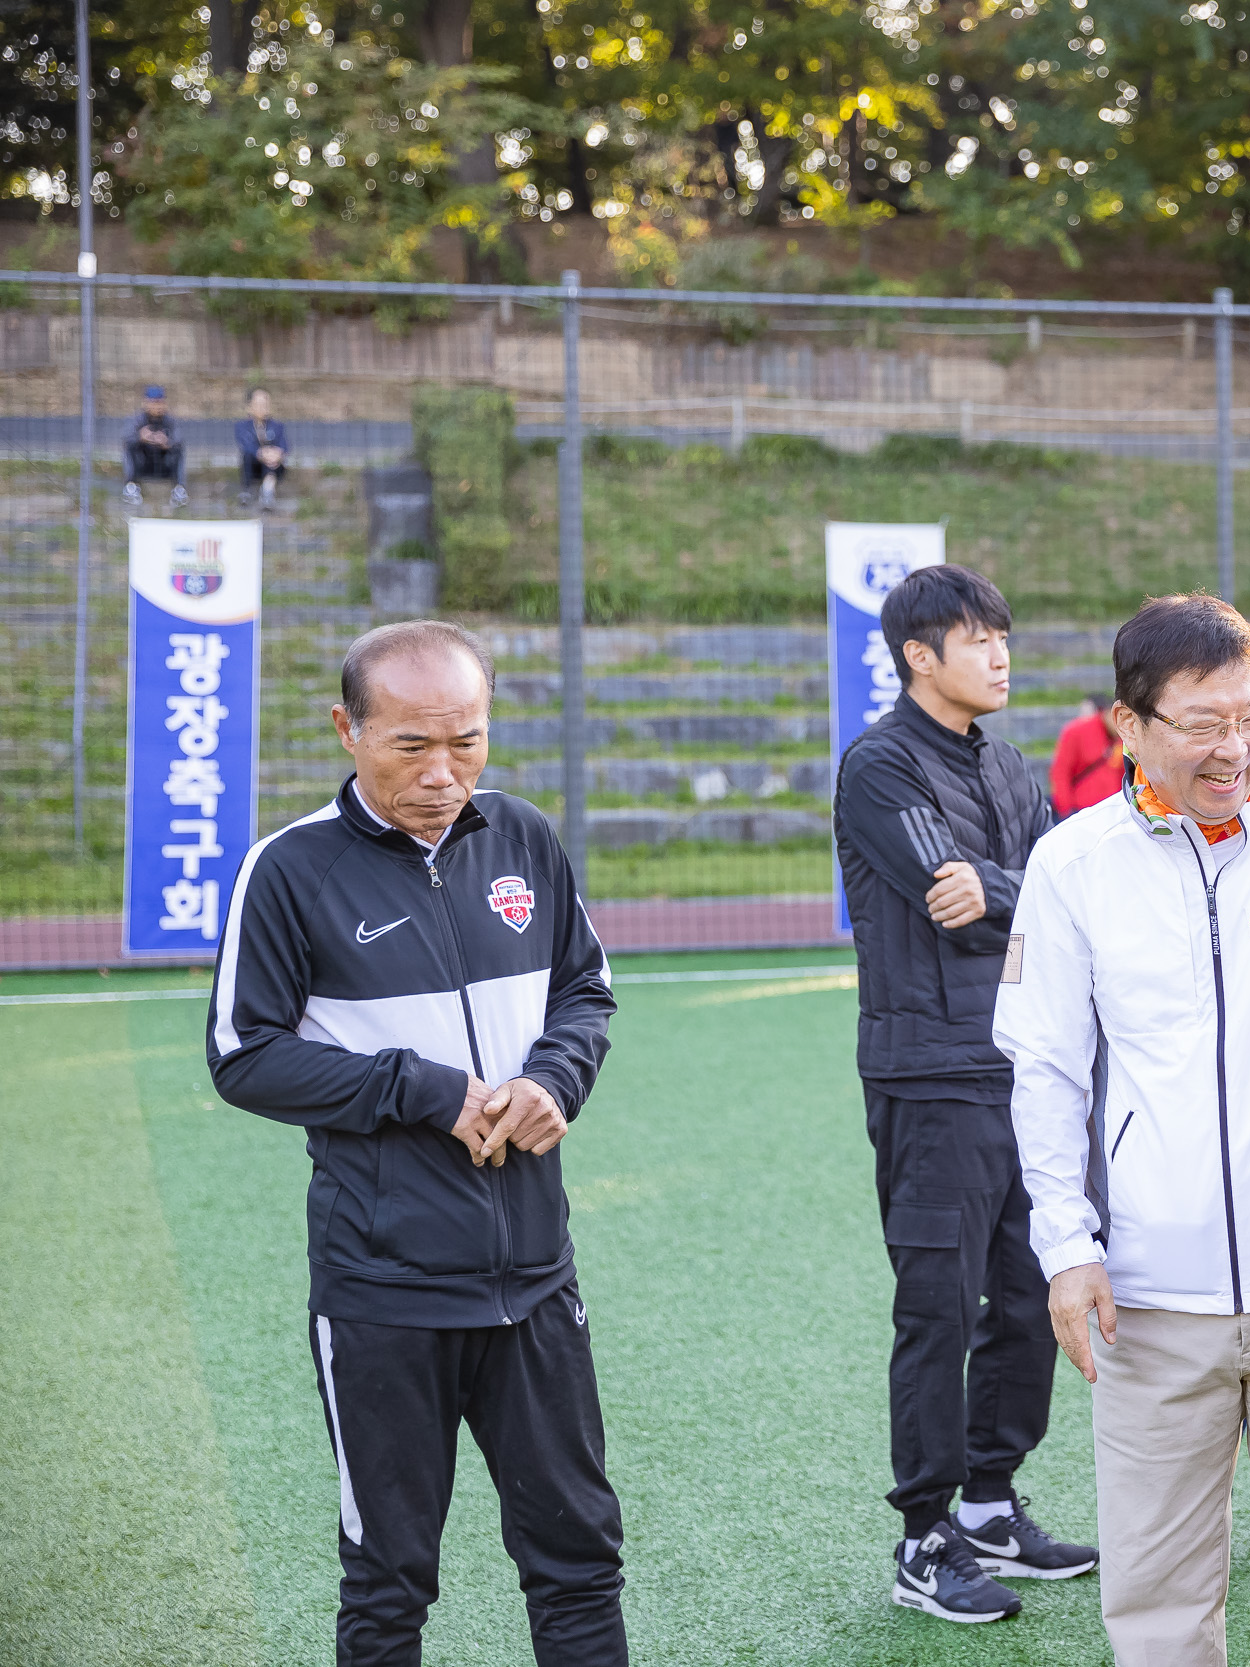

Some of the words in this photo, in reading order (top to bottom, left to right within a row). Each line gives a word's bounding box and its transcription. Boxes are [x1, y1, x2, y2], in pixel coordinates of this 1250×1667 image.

[158, 632, 230, 941] 광장축구회
[492, 896, 514, 907] KANG
[515, 894, 532, 904] BYUN
[1210, 915, 1219, 935] SINCE
[1212, 935, 1221, 955] PUMA
